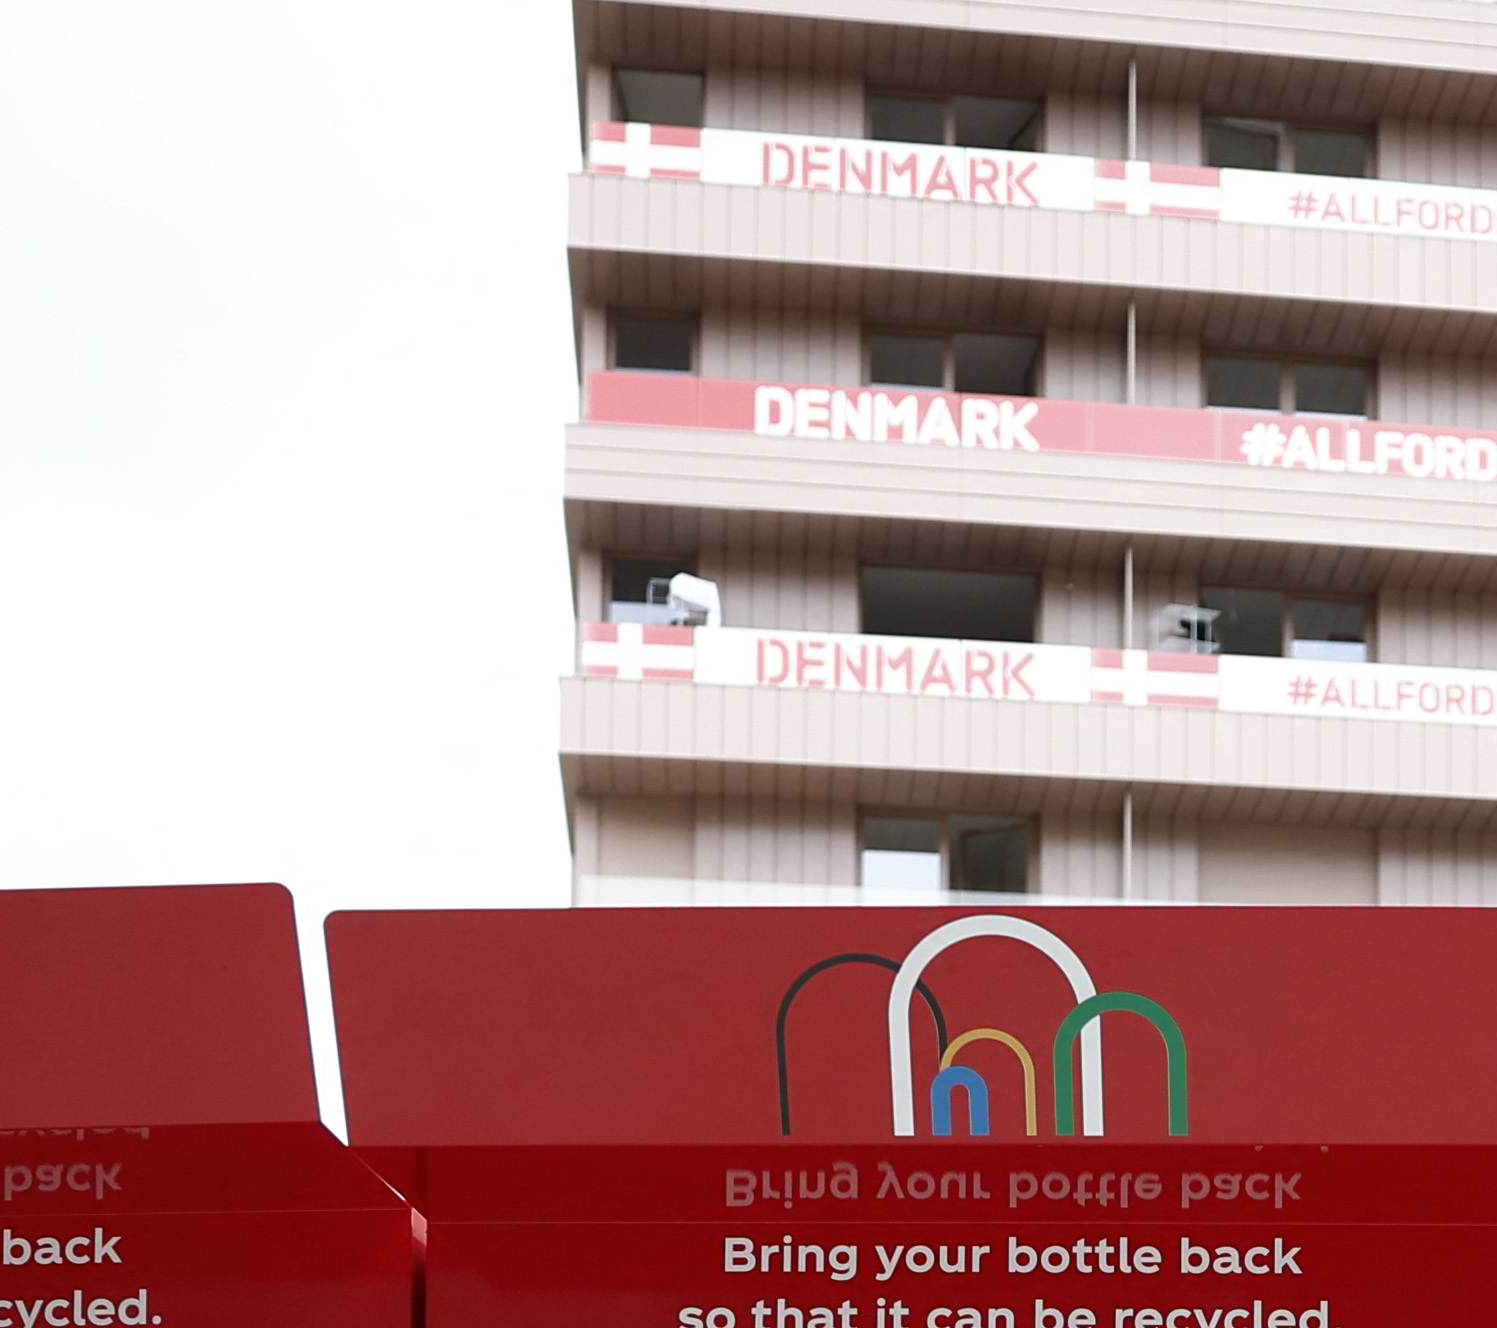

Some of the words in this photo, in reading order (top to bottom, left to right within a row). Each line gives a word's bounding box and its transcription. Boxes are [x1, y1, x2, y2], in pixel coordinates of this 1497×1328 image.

[761, 141, 1040, 207] DENMARK
[753, 385, 1040, 453] DENMARK
[755, 639, 1035, 700] DENMARK
[2, 1227, 123, 1266] back
[724, 1234, 858, 1281] Bring
[874, 1244, 991, 1281] your
[1008, 1236, 1162, 1274] bottle
[1180, 1237, 1303, 1275] back
